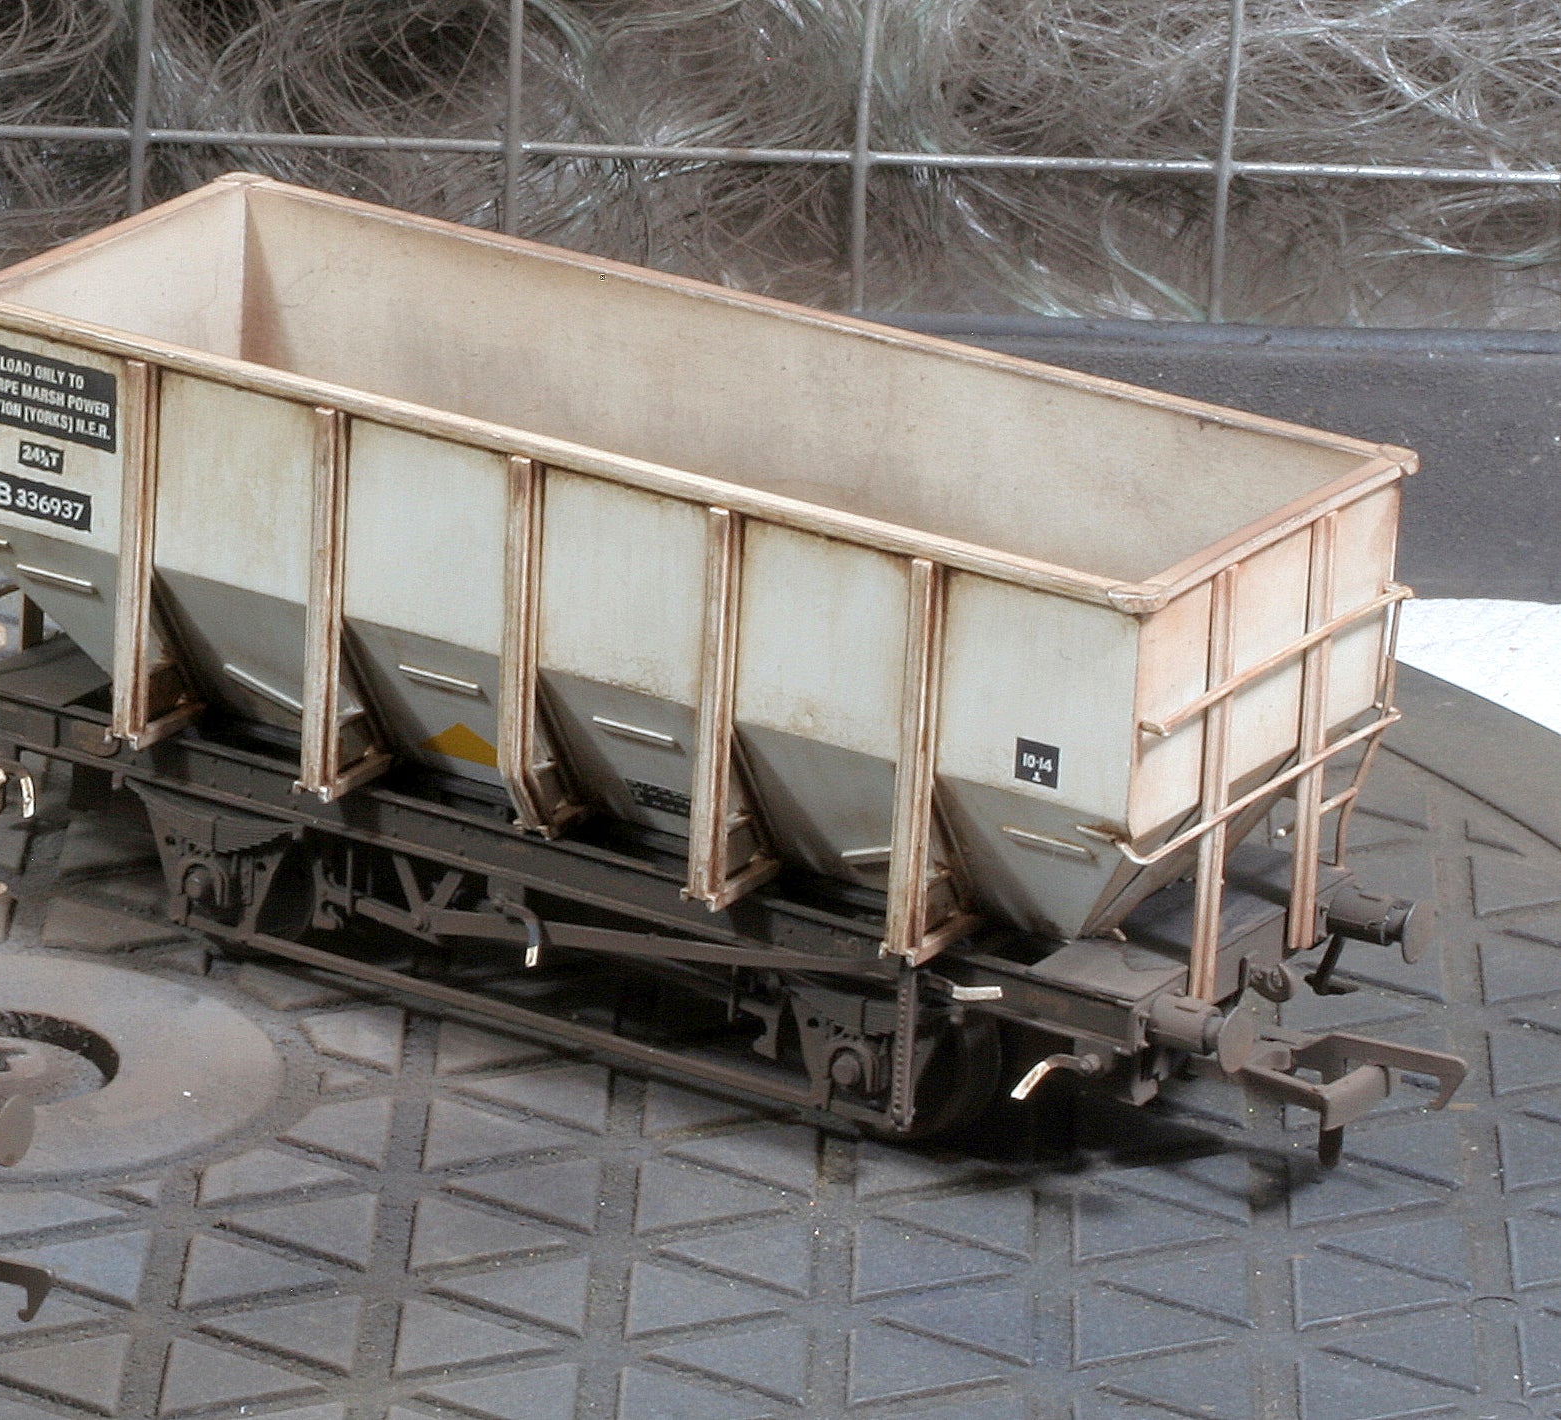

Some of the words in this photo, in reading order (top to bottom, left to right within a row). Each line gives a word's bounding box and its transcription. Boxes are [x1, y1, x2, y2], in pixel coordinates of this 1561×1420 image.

[0, 356, 32, 377] LOAD
[34, 365, 65, 385] ONLY
[69, 373, 85, 390] TO
[21, 383, 65, 405] MARSH
[67, 395, 111, 419] POWER
[15, 488, 85, 521] 336937
